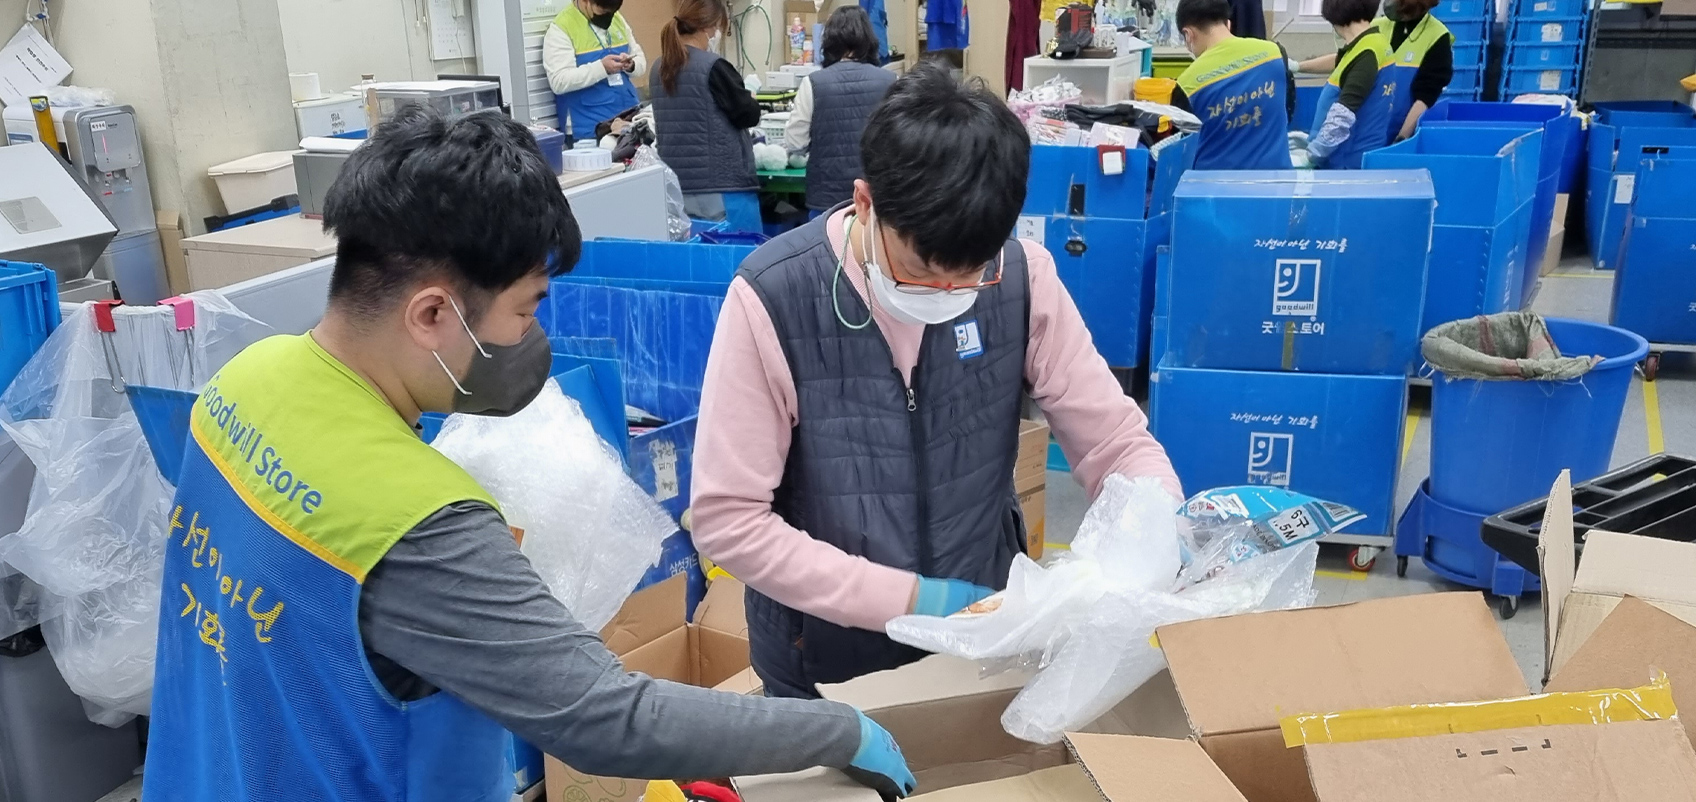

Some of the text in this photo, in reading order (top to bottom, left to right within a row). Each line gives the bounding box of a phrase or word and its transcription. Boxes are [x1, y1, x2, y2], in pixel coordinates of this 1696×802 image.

[1254, 237, 1347, 253] 자선이 아닌 기회를
[1276, 303, 1314, 313] goodwill
[1230, 412, 1318, 429] 자선이 아닌 기회를
[255, 446, 323, 515] Store
[1273, 518, 1298, 541] .5M
[669, 552, 698, 577] 삼성카드
[220, 575, 284, 643] 아닌
